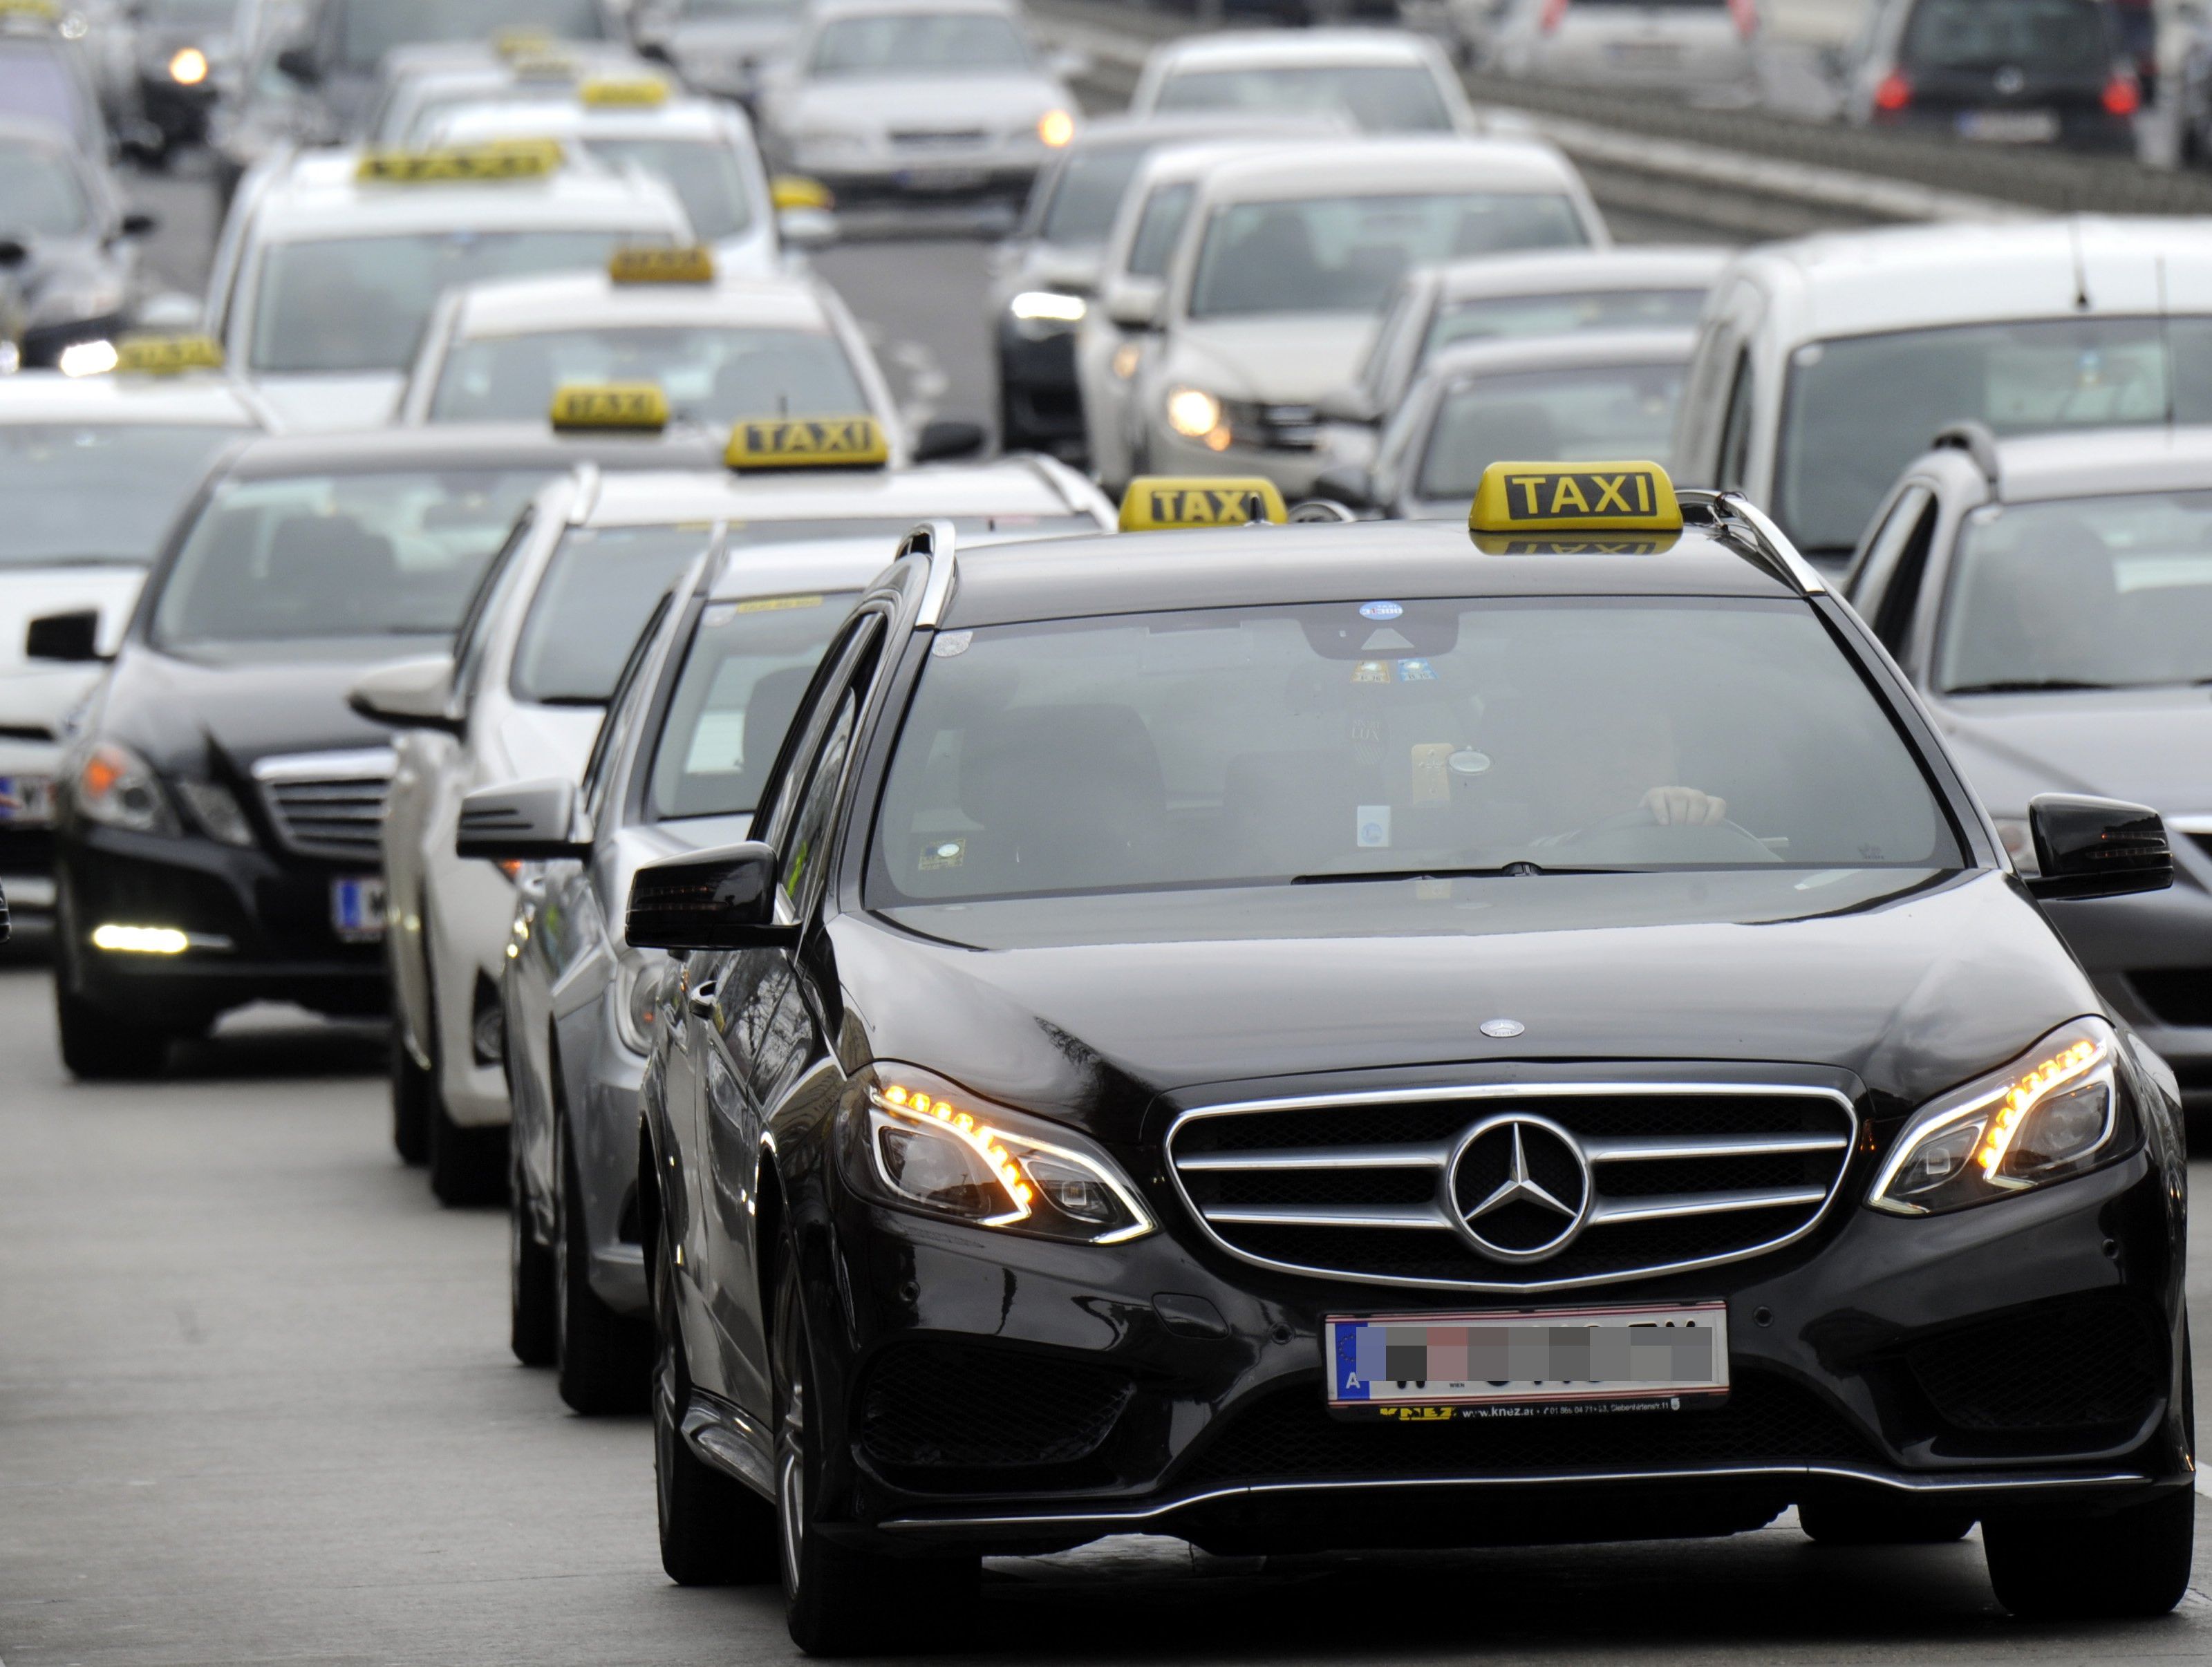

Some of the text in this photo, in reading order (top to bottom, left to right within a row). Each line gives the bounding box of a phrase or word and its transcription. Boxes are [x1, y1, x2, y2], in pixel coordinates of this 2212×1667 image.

[751, 421, 865, 453] TAXI
[1512, 475, 1650, 514] TAXI
[1346, 1372, 1360, 1389] A
